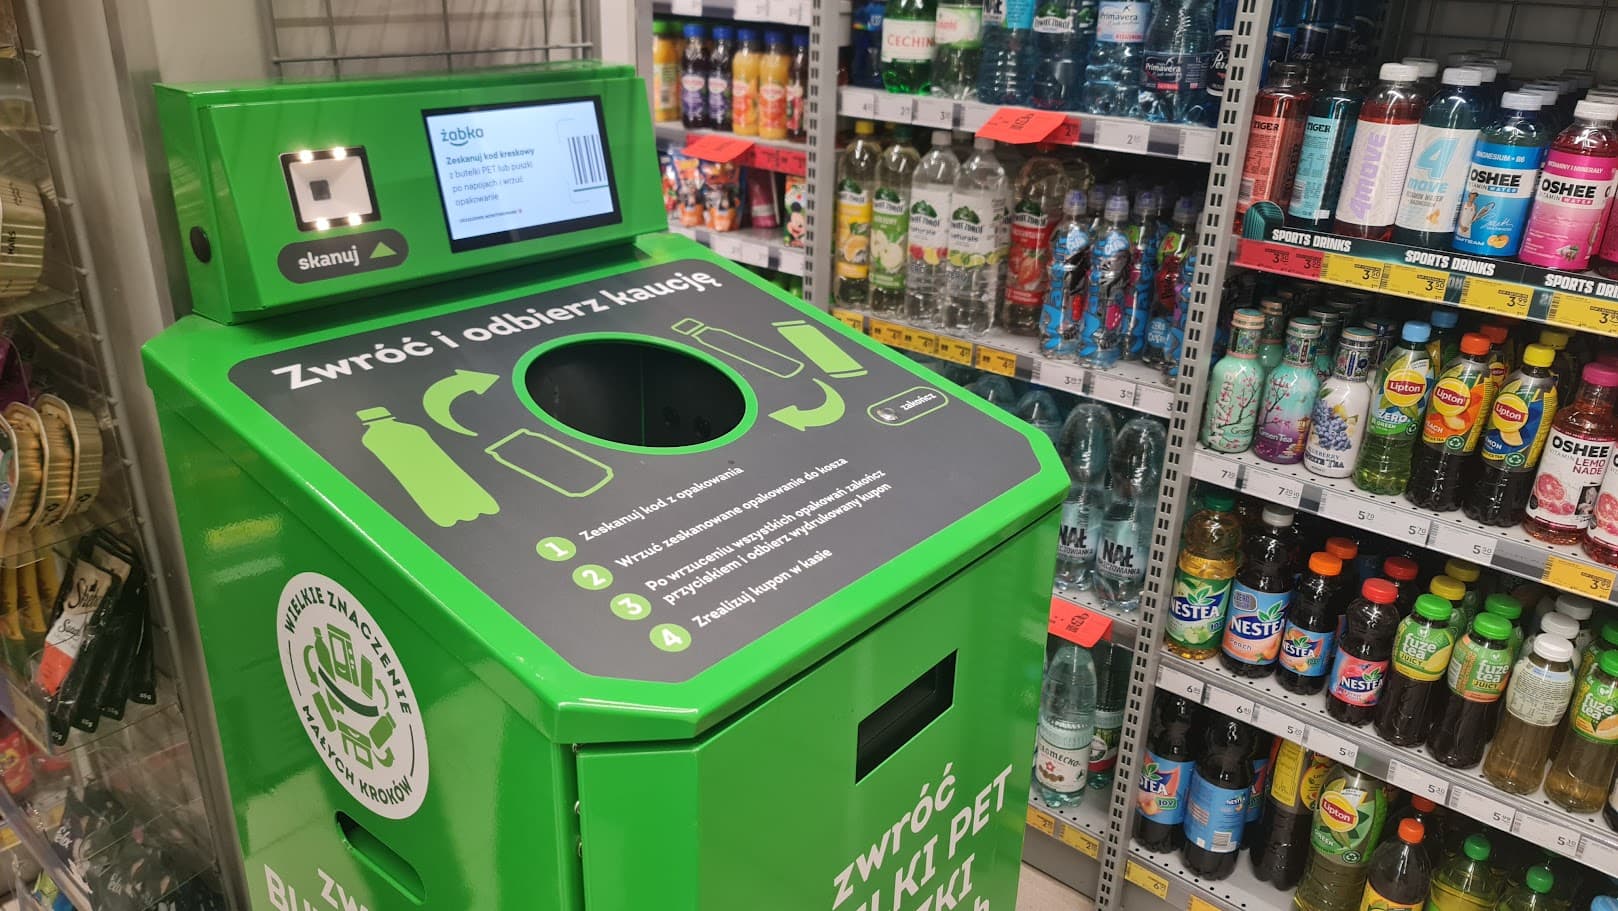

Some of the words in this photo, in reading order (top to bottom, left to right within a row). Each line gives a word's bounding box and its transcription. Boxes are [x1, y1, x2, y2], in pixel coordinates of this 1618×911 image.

[440, 126, 484, 142] żabka
[1253, 121, 1280, 131] TIGER
[1306, 122, 1331, 133] TIGER
[1127, 134, 1133, 144] 2
[446, 153, 483, 165] Zeskanuj
[484, 150, 498, 160] kod
[499, 148, 535, 160] kreskowy
[1414, 136, 1460, 179] 4
[455, 167, 481, 179] butelki
[482, 166, 496, 174] PET
[497, 164, 510, 173] lub
[1470, 169, 1522, 188] OSHEE
[464, 180, 498, 192] napojach
[1542, 179, 1596, 198] OSHEE
[456, 193, 498, 207] opakowanie
[1272, 228, 1310, 246] SPORTS
[1313, 234, 1352, 252] DRINKS
[298, 245, 360, 271] skanuj
[1405, 250, 1449, 268] SPORTS
[1452, 256, 1496, 276] DRINKS
[1544, 274, 1595, 294] SPORTS
[271, 336, 434, 390] Zwróć
[430, 330, 459, 348] i
[462, 297, 610, 342] odbierz
[600, 270, 722, 306] kaucję
[1390, 382, 1420, 392] Lipton
[900, 392, 936, 410] zakończ
[1436, 388, 1464, 405] Lipton
[1378, 410, 1408, 423] ZERO
[1496, 404, 1522, 420] Lipton
[1552, 436, 1610, 458] OSHEE
[578, 510, 646, 541] Zeskanuj
[639, 498, 668, 514] kod
[666, 496, 678, 504] z
[676, 466, 744, 498] opakowania
[614, 542, 664, 568] Wrzuć
[662, 507, 743, 548] zeskanowane
[742, 477, 806, 509] opakowanie
[804, 470, 820, 480] do
[815, 458, 848, 474] kosza
[644, 578, 668, 592] Po
[667, 545, 735, 581] wrzuceniu
[732, 513, 797, 549] wszystkich
[795, 488, 848, 518] opakowań
[844, 470, 886, 492] zakończ
[1408, 526, 1416, 535] 5
[545, 542, 568, 557] 1
[662, 558, 742, 606] przyciskiem
[737, 554, 748, 564] i
[746, 532, 792, 560] odbierz
[788, 498, 862, 536] wydrukowany
[856, 482, 892, 502] kupon
[1472, 544, 1481, 554] 5
[1102, 539, 1134, 568] NAŁ
[582, 570, 606, 586] 2
[1590, 578, 1598, 590] 3
[690, 590, 756, 628] Zrealizuj
[748, 572, 792, 596] kupon
[789, 564, 802, 574] w
[797, 549, 832, 568] kasie
[618, 598, 642, 615] 3
[662, 628, 683, 646] 4
[1404, 632, 1436, 653] fuze
[284, 586, 326, 634] WIELKIE
[327, 591, 412, 715] ZNACZENIE
[1401, 652, 1424, 666] JUICY
[1402, 644, 1426, 660] tea
[1479, 660, 1510, 674] fuze
[1473, 680, 1498, 690] JUICY
[1477, 672, 1502, 683] tea
[1582, 704, 1602, 720] tea
[1583, 692, 1614, 716] fuze
[302, 705, 354, 785] MAŁYCH
[359, 775, 414, 805] KROKÓW
[1428, 785, 1435, 794] 5
[948, 764, 1012, 860] PET
[1323, 801, 1350, 822] Lipton
[1494, 812, 1500, 822] 5
[832, 762, 956, 911] zwróć
[1558, 836, 1566, 846] 5
